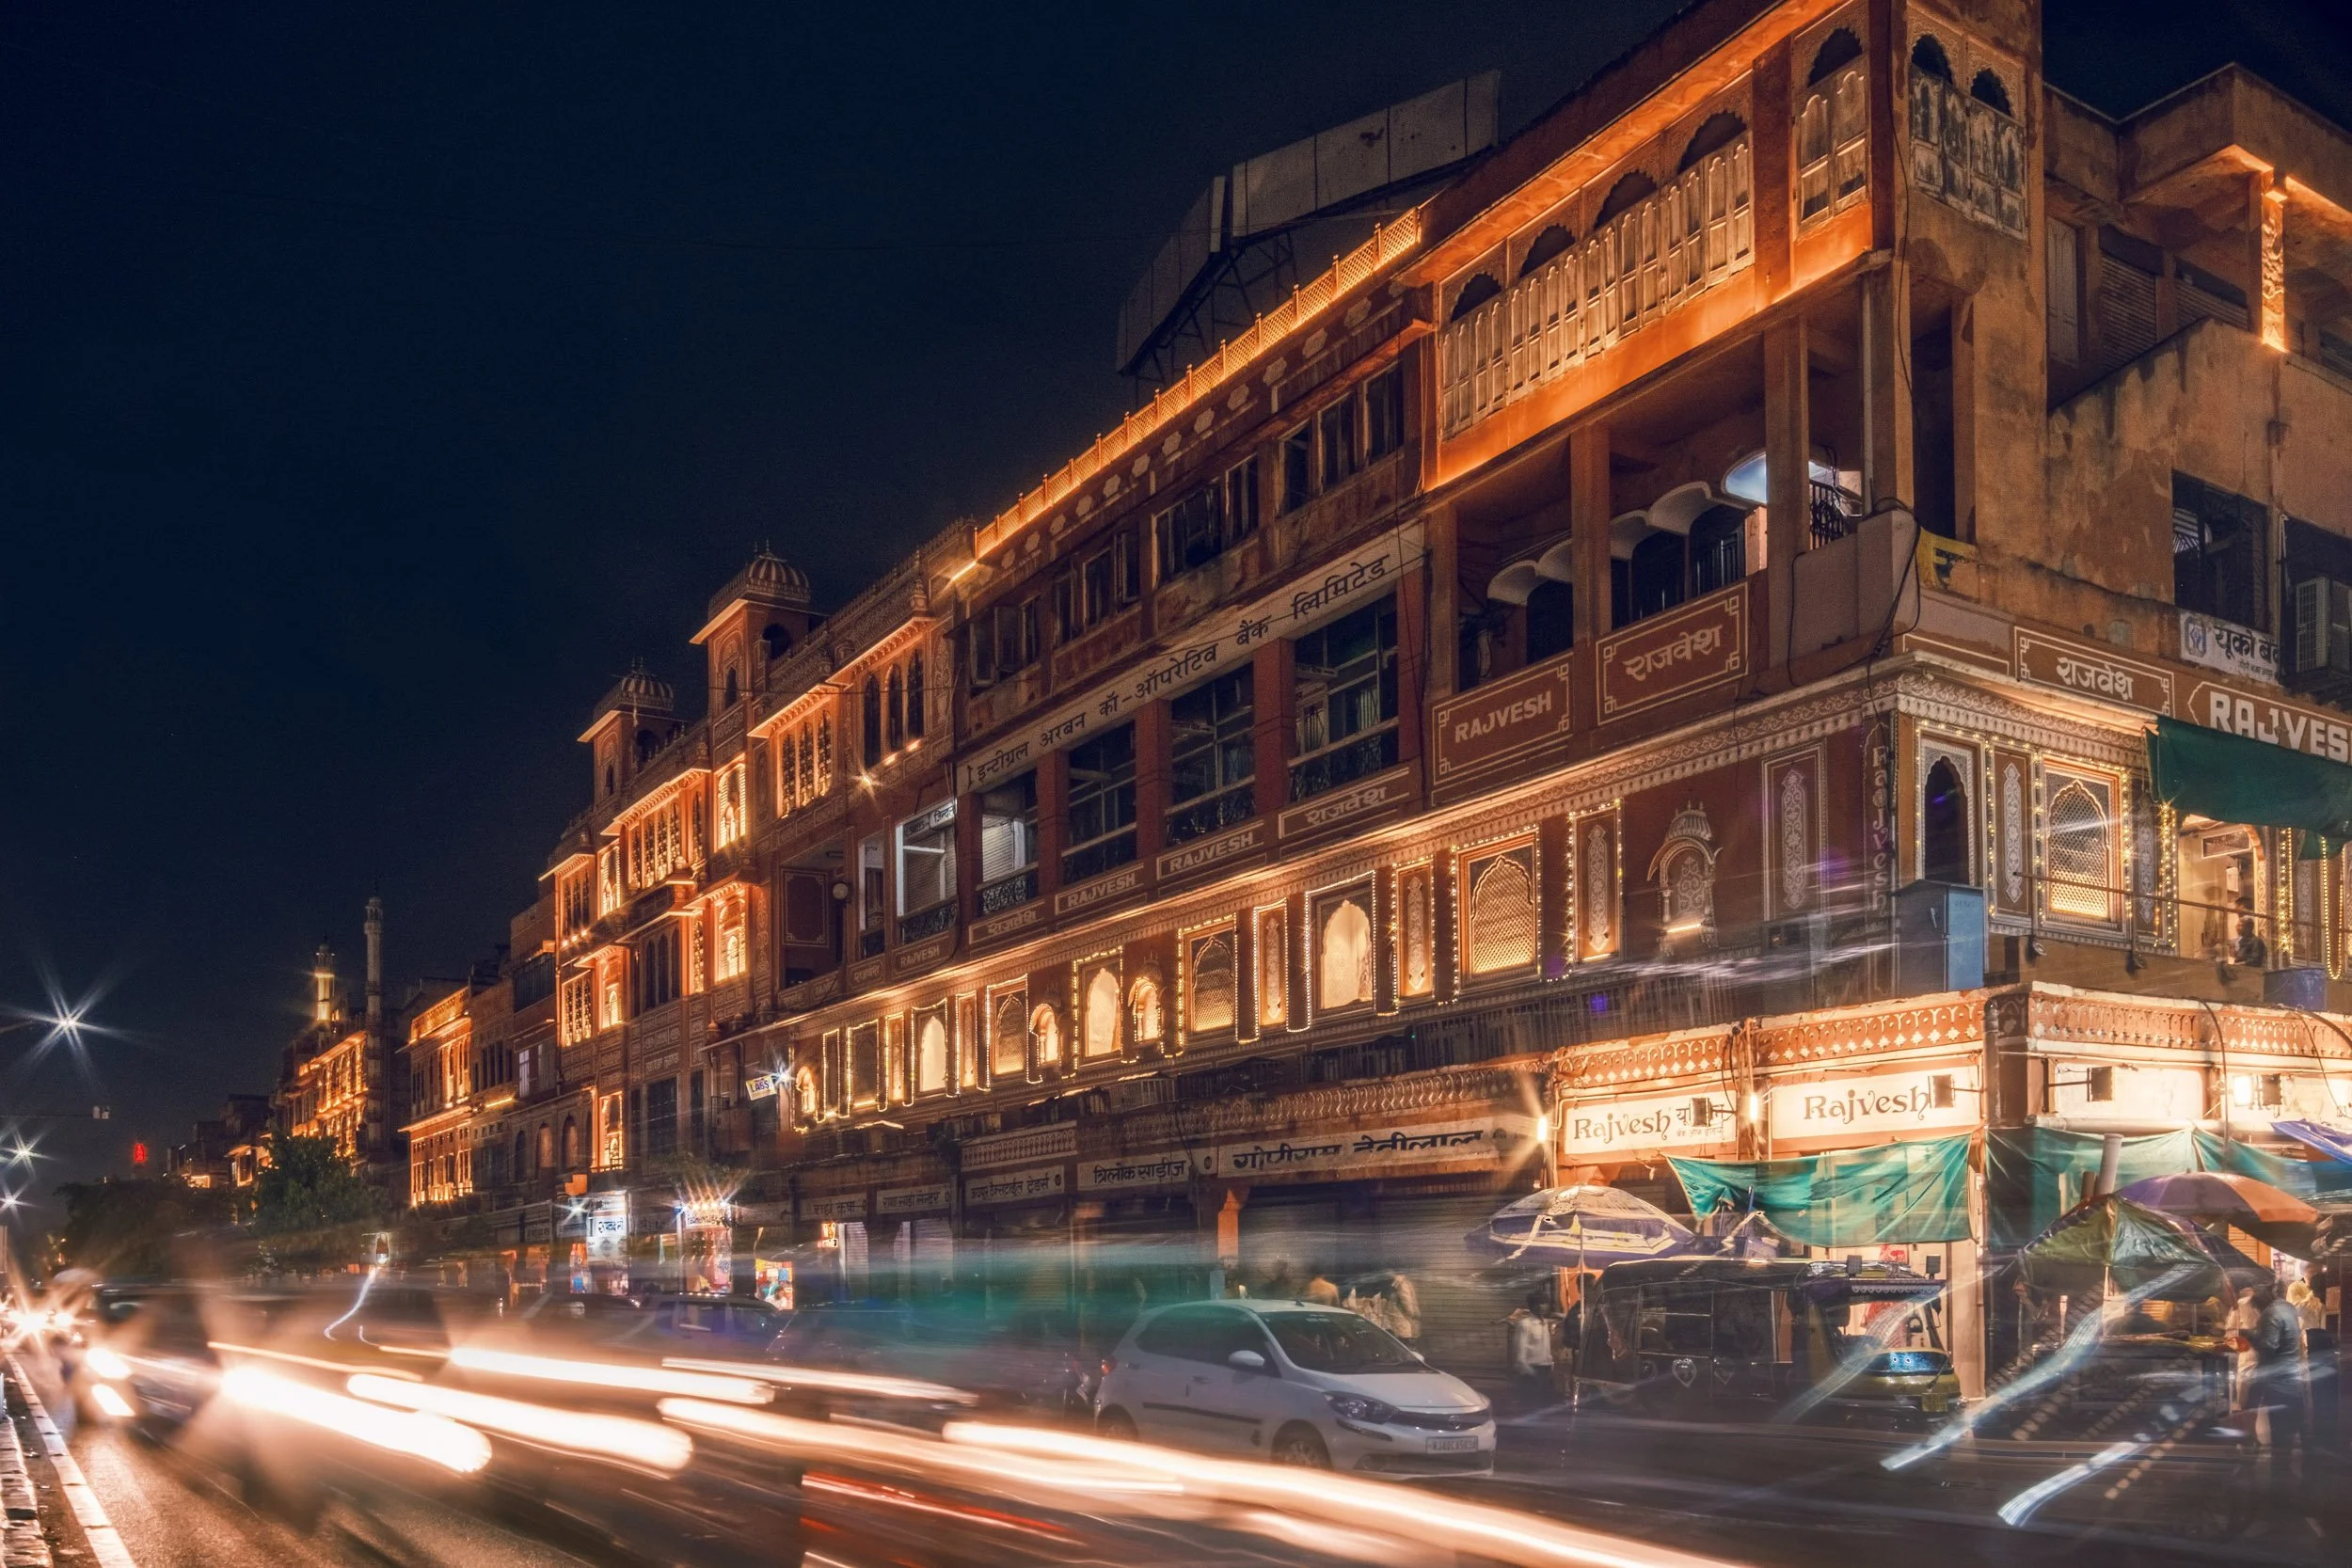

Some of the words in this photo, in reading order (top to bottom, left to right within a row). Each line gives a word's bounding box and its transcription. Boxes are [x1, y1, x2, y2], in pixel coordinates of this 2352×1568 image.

[1040, 711, 1086, 747] अरबन
[1236, 615, 1272, 645] बैंक
[1291, 553, 1391, 621] लिमिटेड
[1623, 624, 1724, 682] राजवेश
[2214, 626, 2256, 660] यूको
[2056, 657, 2134, 701] राजवेश
[1454, 690, 1552, 743] RAJVESH
[2209, 691, 2352, 766] RAJVES
[1306, 784, 1388, 826] राजवेश
[1169, 832, 1254, 872] RAJVESH
[1068, 873, 1136, 907] RAJVESH
[900, 945, 940, 967] RAJVESH
[750, 1080, 771, 1092] LASS
[1804, 1085, 1931, 1125] Rajvesh
[1573, 1107, 1672, 1145] Rajvesh
[1093, 1161, 1135, 1184] त्रिलोक
[1136, 1156, 1186, 1182] साड़ीज
